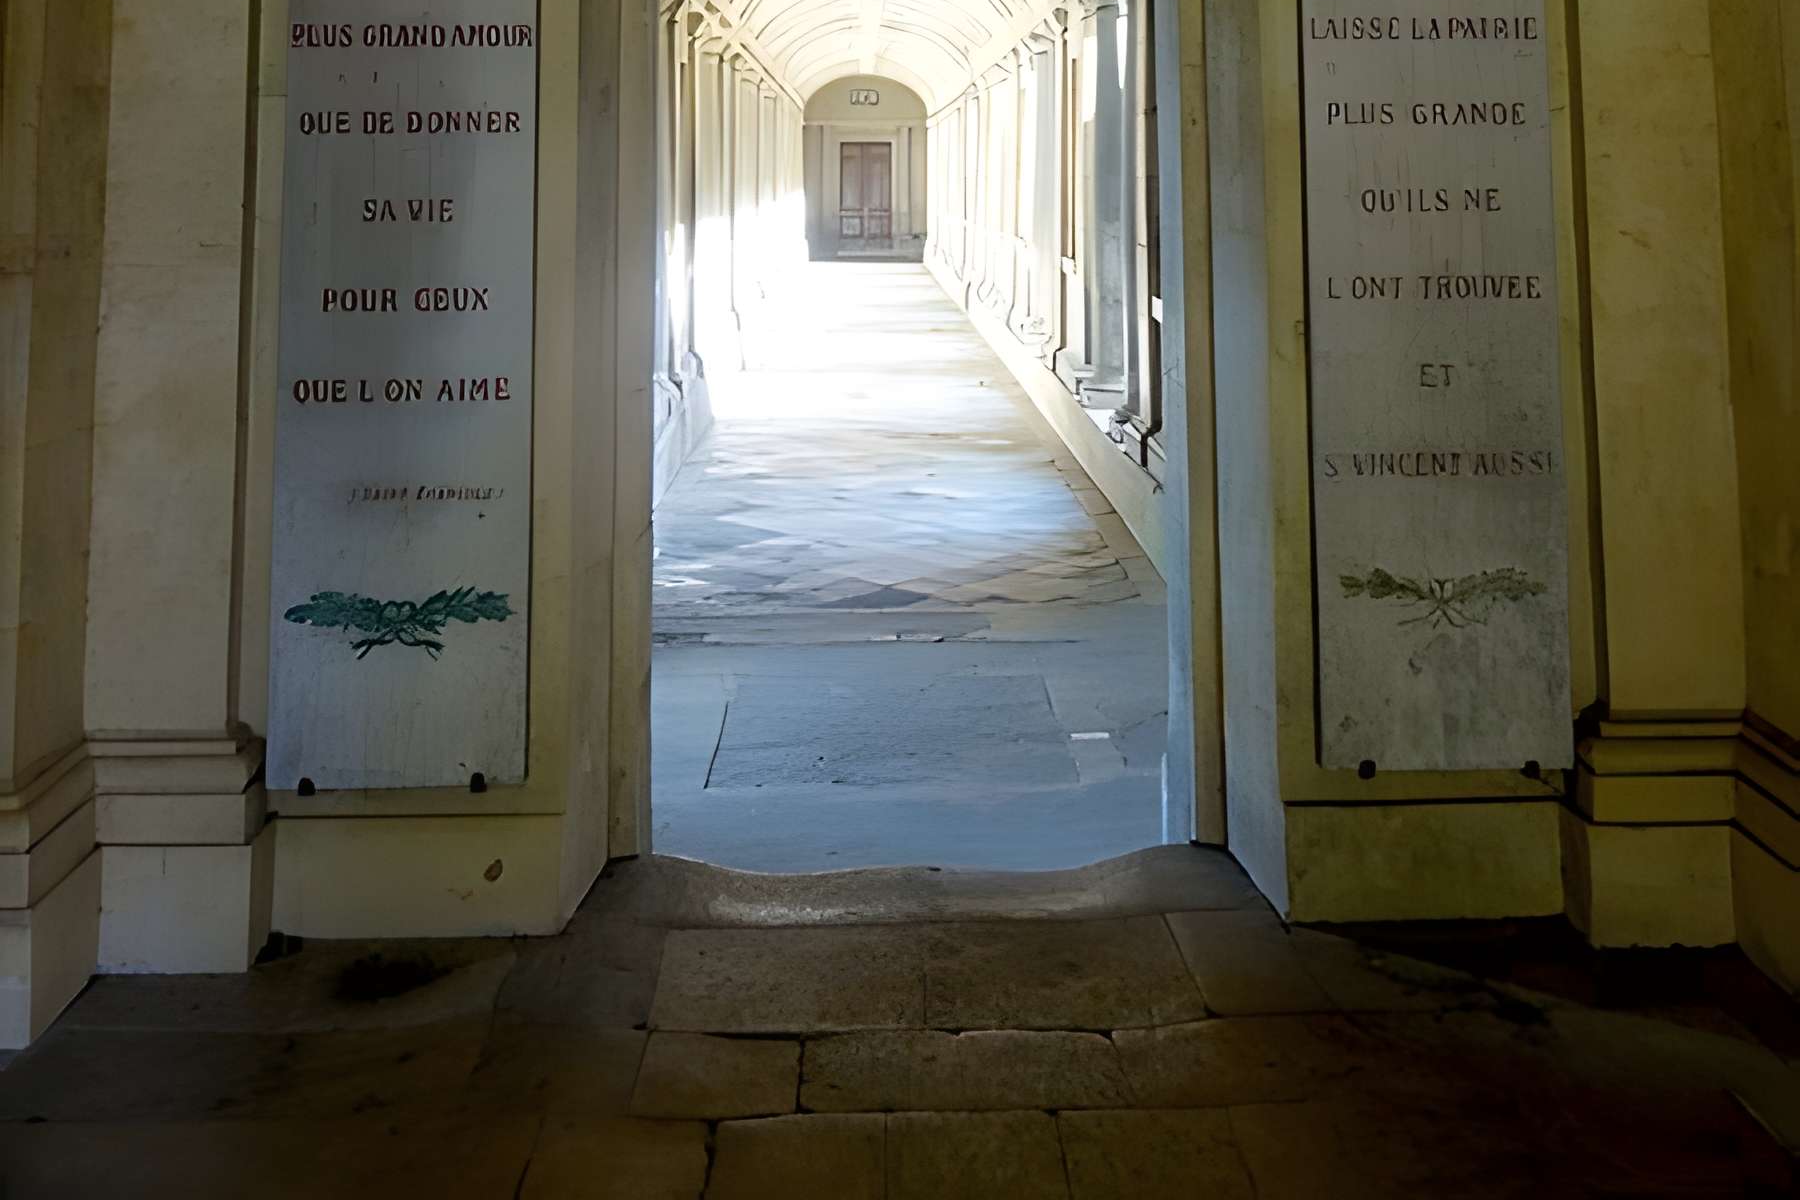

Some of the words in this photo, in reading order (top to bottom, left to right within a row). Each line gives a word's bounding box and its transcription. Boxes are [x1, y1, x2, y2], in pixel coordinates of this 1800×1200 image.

[292, 24, 353, 48] PLUS
[363, 24, 446, 47] GRAND
[451, 24, 533, 47] AMOUR
[1412, 17, 1441, 40] LA
[300, 111, 351, 135] QUE
[363, 111, 394, 134] DE
[406, 111, 520, 134] DONNER
[1327, 102, 1394, 125] PLUS
[1412, 103, 1526, 125] GRANDE
[363, 199, 397, 222] SA
[409, 199, 454, 222] VIE
[1464, 188, 1502, 212] NE
[323, 288, 398, 312] POUR
[1420, 364, 1455, 387] ET
[293, 379, 347, 404] QUE
[437, 377, 512, 402] AIME
